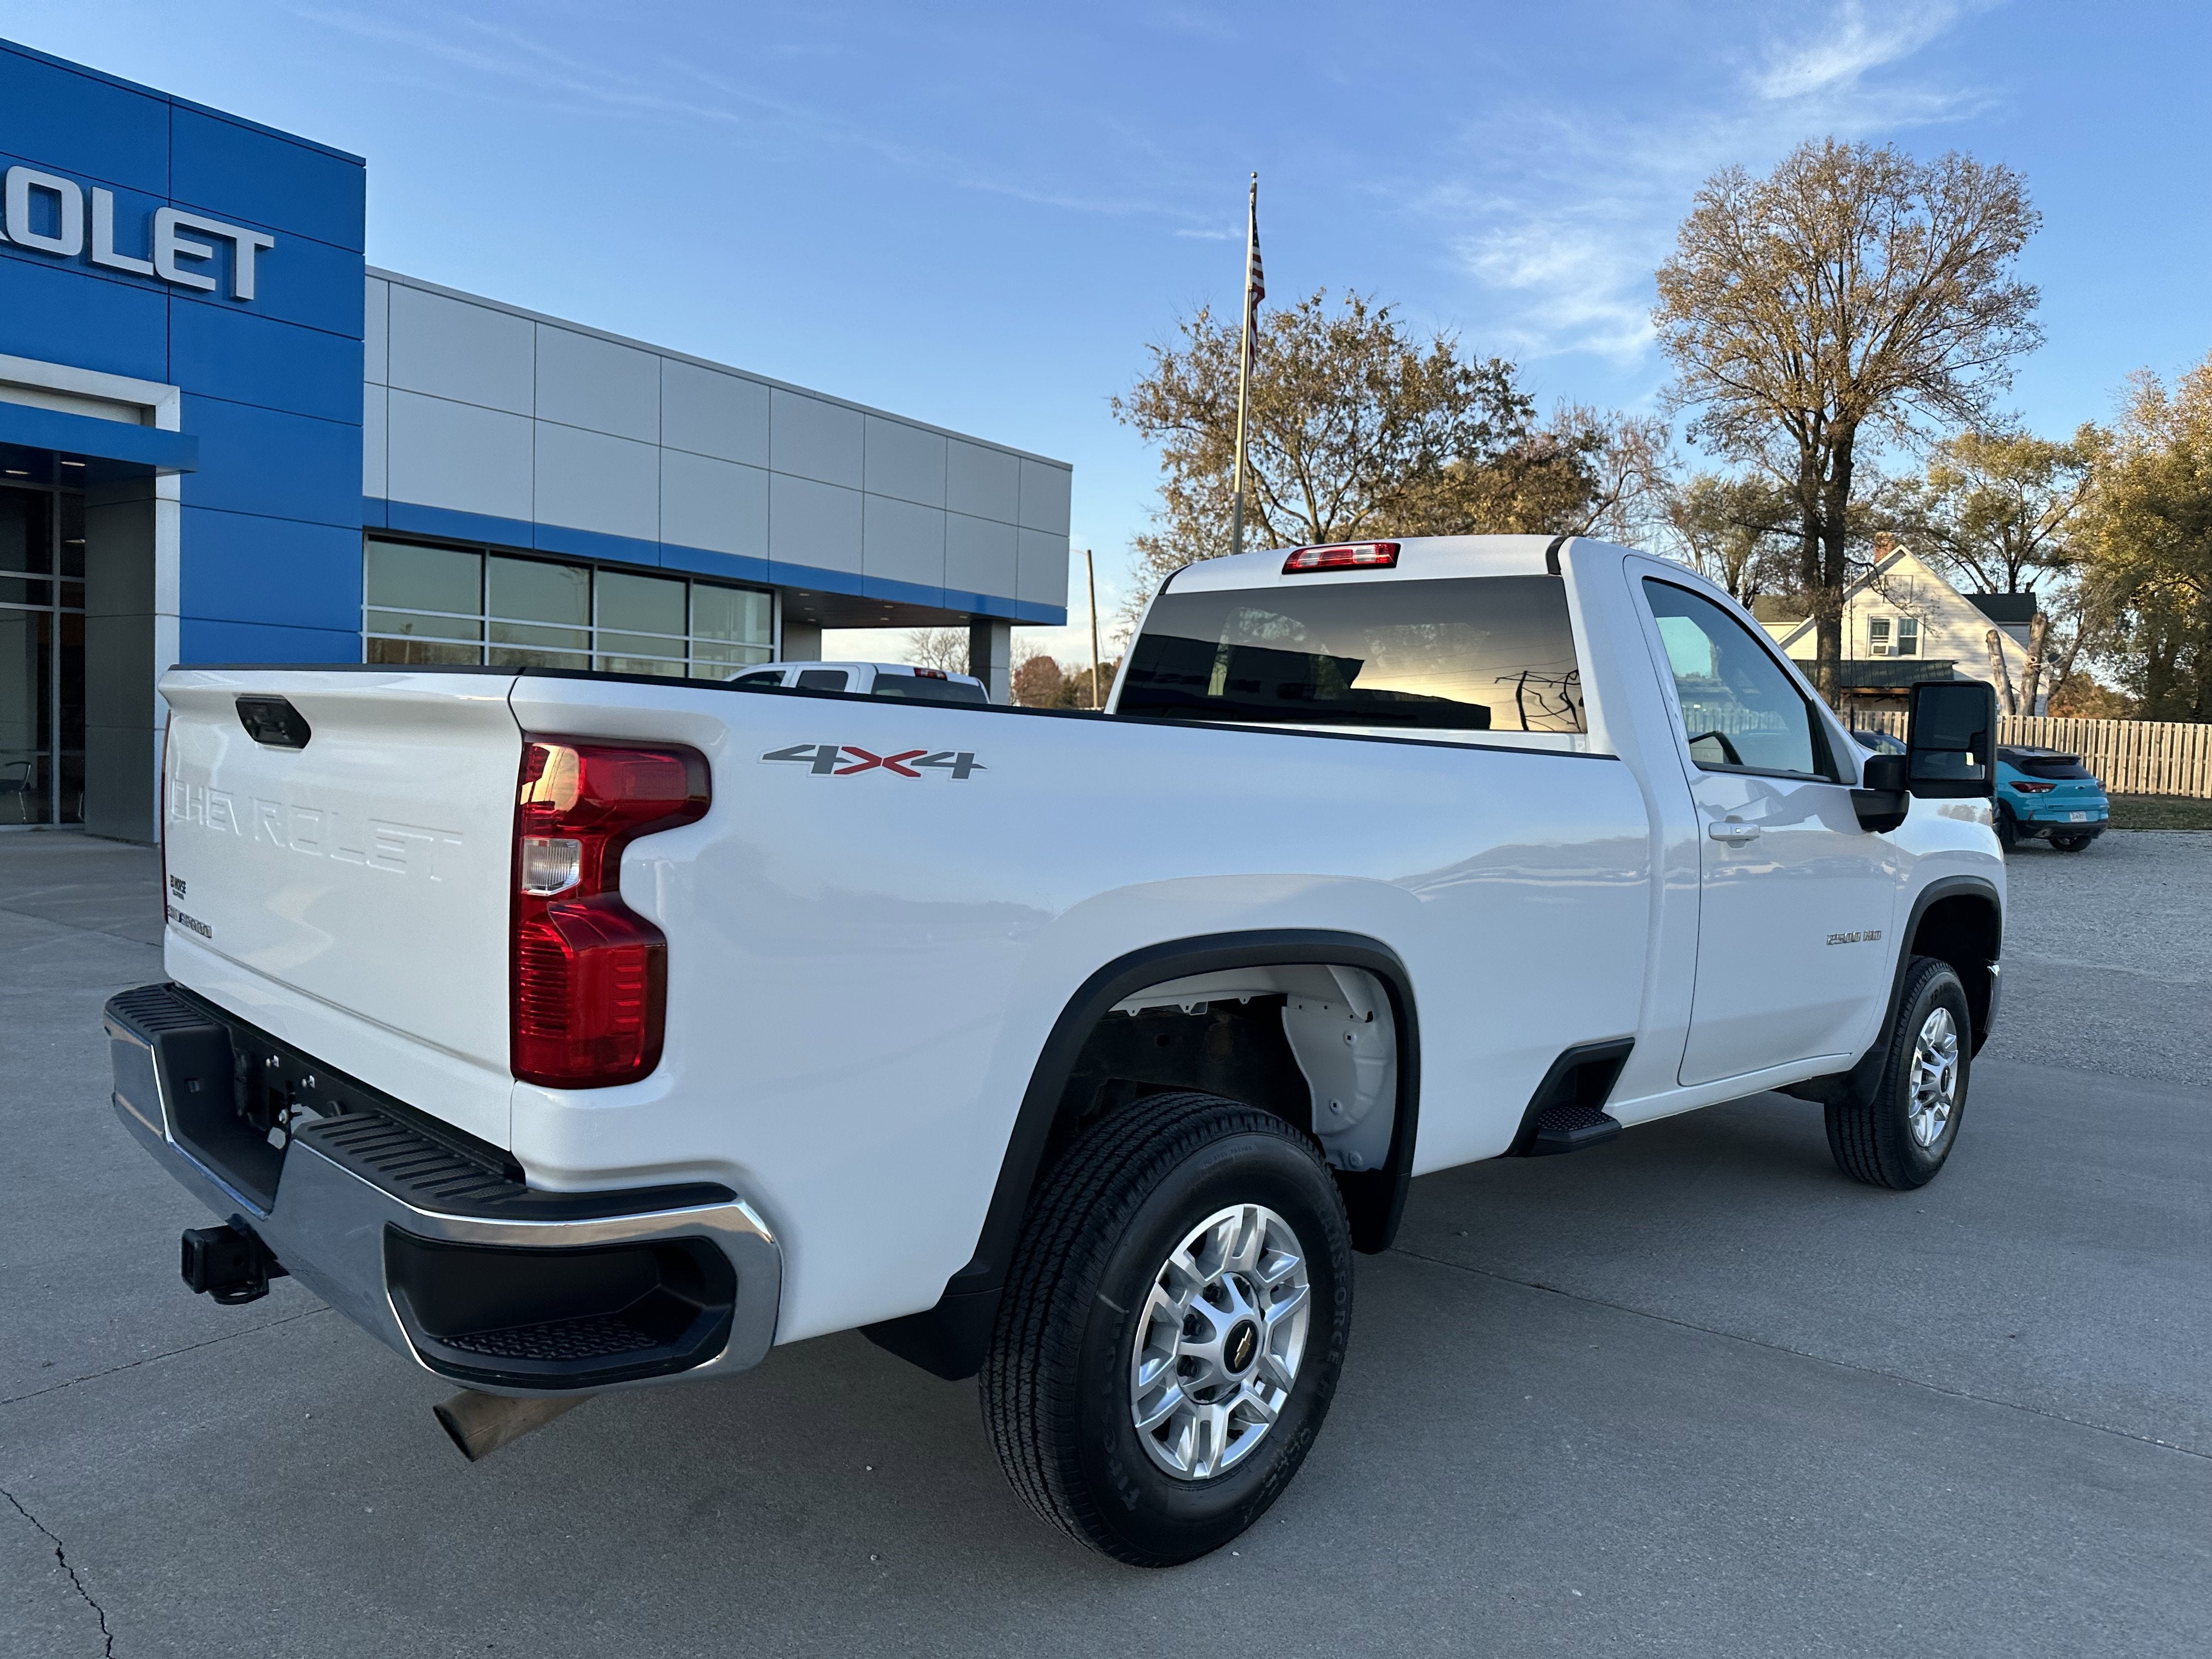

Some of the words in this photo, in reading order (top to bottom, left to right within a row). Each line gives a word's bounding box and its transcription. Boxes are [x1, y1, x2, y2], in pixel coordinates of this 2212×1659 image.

[0, 166, 274, 300] OLET
[169, 779, 463, 882] CHEVROLET
[1826, 932, 1861, 945] 2500
[1863, 930, 1882, 941] HD
